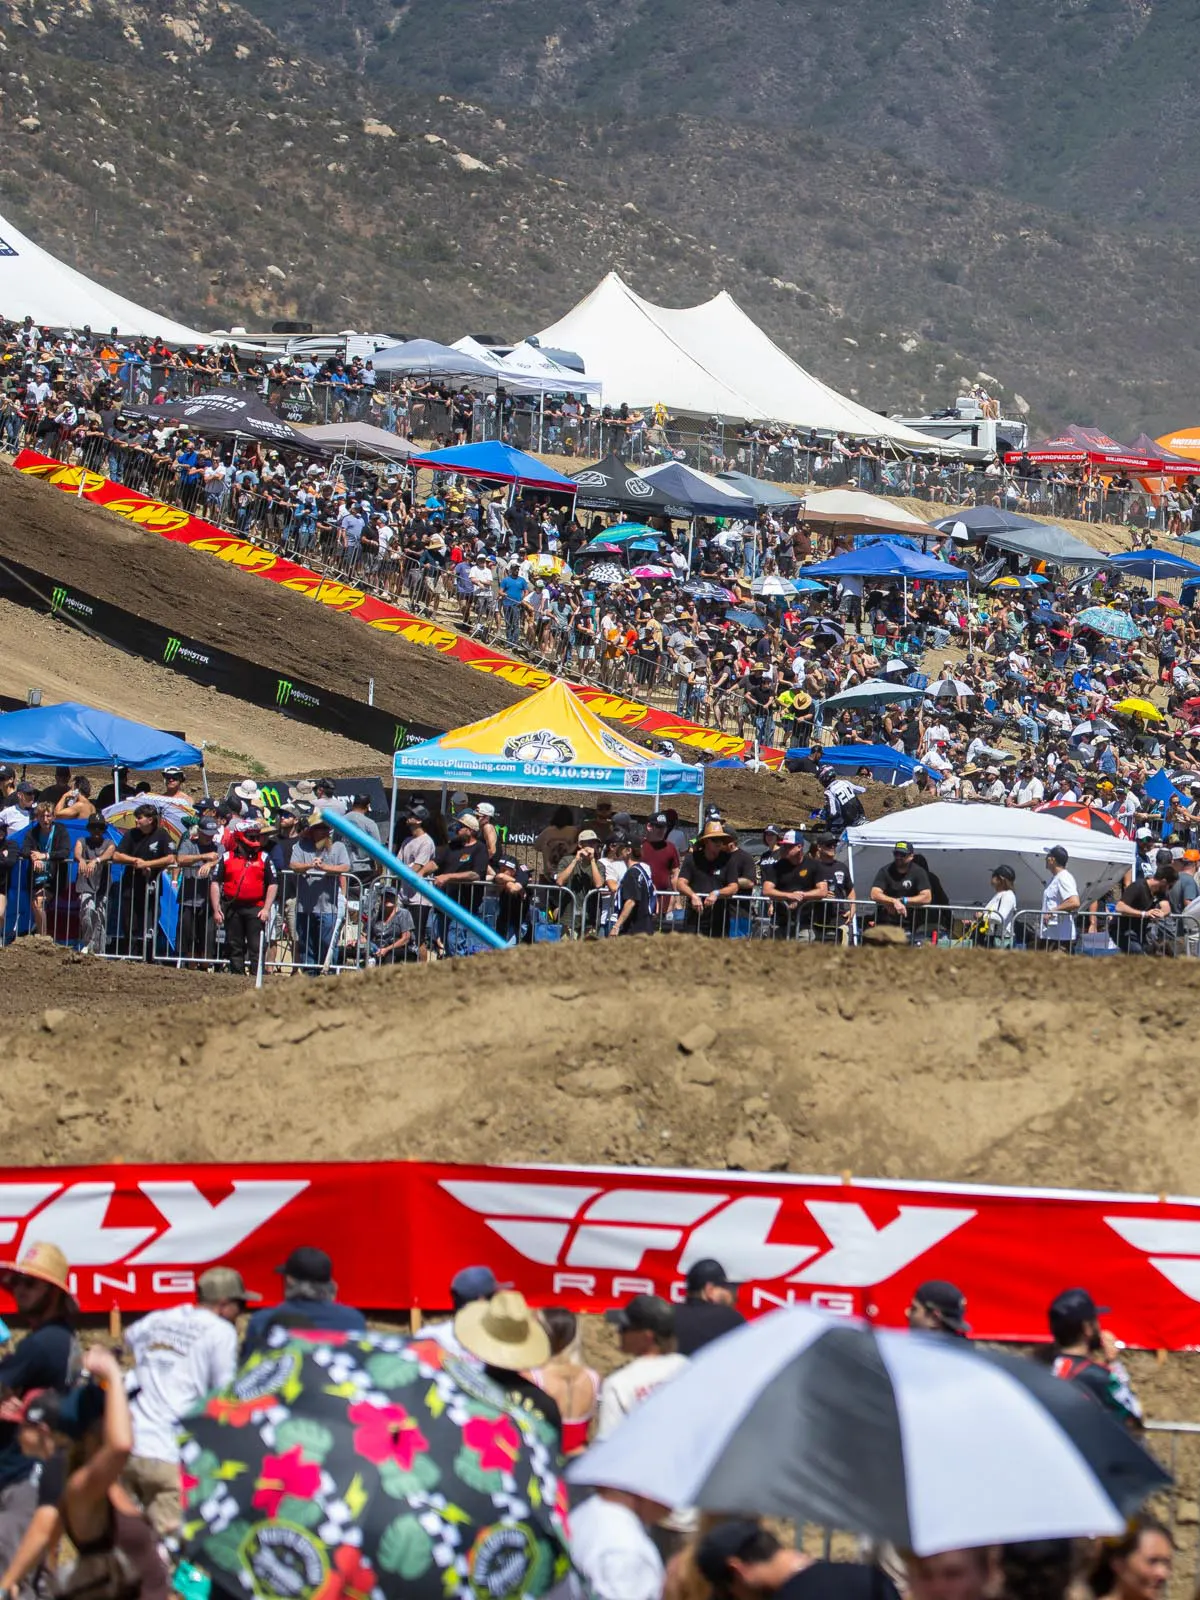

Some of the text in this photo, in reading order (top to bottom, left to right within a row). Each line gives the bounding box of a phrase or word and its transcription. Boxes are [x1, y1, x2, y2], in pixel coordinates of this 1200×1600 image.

[401, 756, 516, 772] BestCoastPlumbing.com
[523, 763, 612, 781] 805.410.9197
[0, 1178, 311, 1266] LY
[438, 1179, 978, 1287] FLY
[68, 1270, 195, 1294] ING
[553, 1272, 854, 1316] RANG
